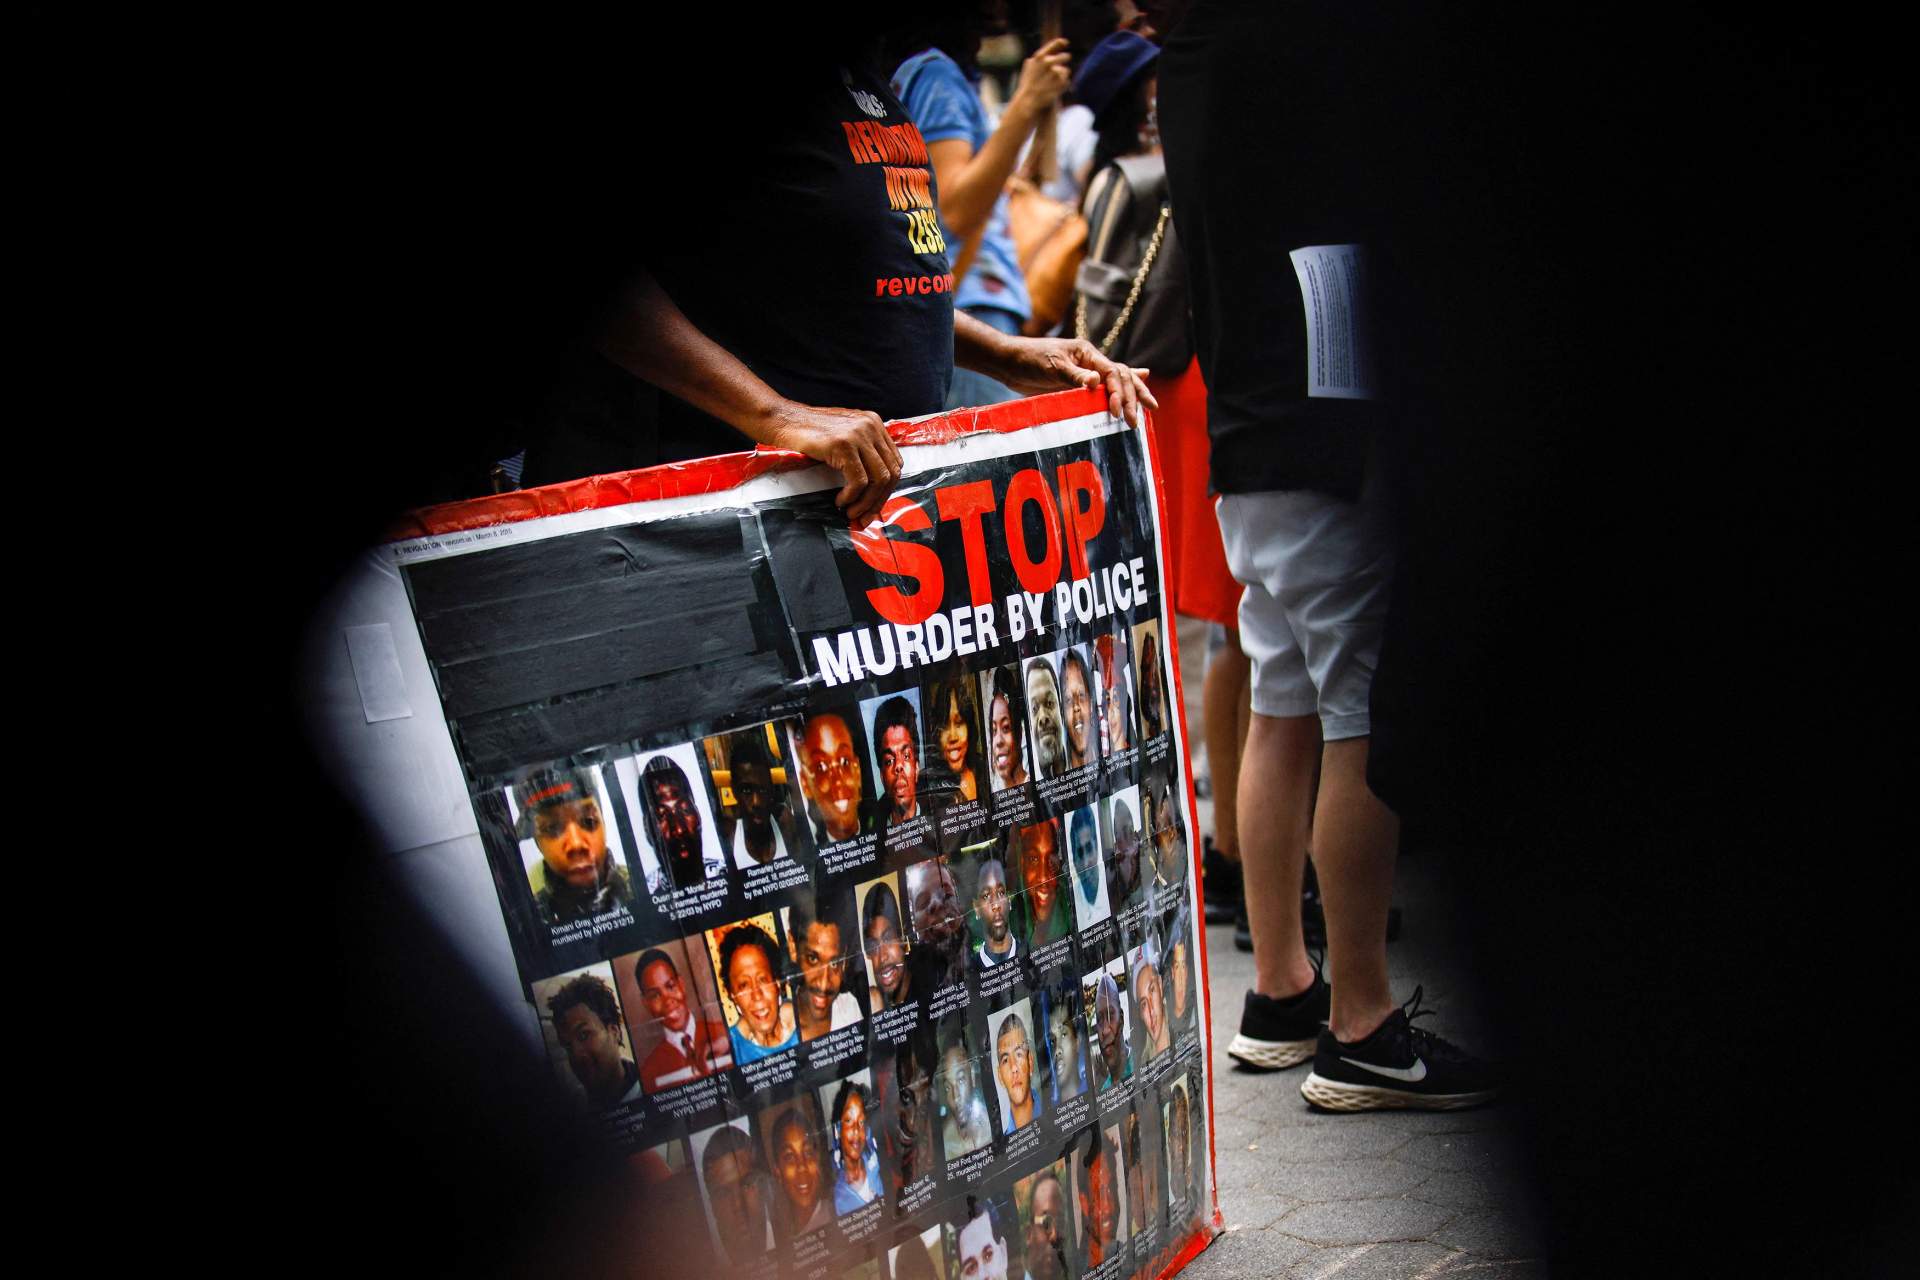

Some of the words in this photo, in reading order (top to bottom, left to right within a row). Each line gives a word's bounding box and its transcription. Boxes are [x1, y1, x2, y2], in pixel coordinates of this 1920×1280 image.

[849, 460, 1106, 626] STOP
[812, 602, 999, 688] MURDER
[1006, 591, 1047, 644] BY
[1055, 557, 1149, 630] POLICE
[819, 847, 836, 857] James
[844, 849, 862, 859] Orleans
[862, 844, 876, 855] police
[779, 866, 806, 879] murdered
[827, 865, 844, 876] during
[763, 883, 779, 893] NYPD
[700, 889, 728, 902] murdered
[703, 899, 722, 911] NYPD
[552, 931, 583, 946] murdered
[593, 922, 612, 934] NYPD
[881, 1017, 904, 1030] murdered
[889, 1027, 904, 1037] transit
[812, 1038, 830, 1049] Ronald
[814, 1057, 834, 1069] Orleans
[746, 1069, 773, 1083] murdered
[956, 1164, 978, 1177] murdered
